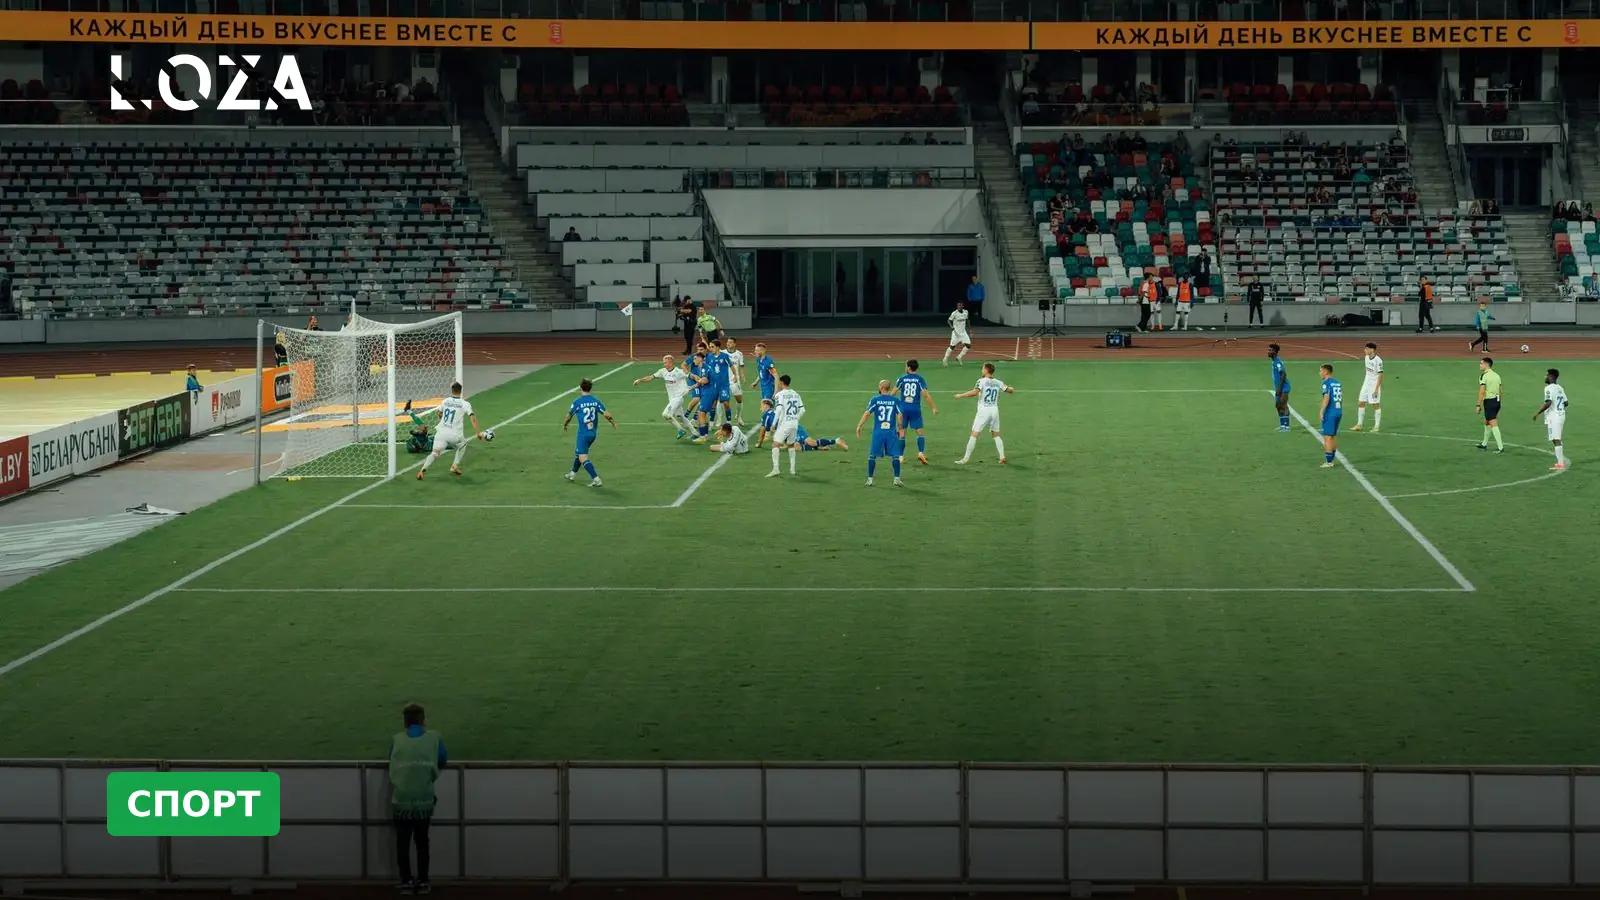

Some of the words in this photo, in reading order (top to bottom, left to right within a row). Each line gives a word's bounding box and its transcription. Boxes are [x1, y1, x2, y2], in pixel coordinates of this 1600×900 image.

[70, 17, 187, 39] КАЖДЫЙ
[198, 21, 265, 41] ДЕНЬ
[274, 22, 387, 41] ВКУСНЕЕ
[396, 24, 493, 42] ВМЕСТЕ
[502, 25, 517, 42] С
[1096, 24, 1208, 47] КАЖДЫЙ
[1218, 27, 1283, 47] ДЕНЬ
[1292, 26, 1402, 44] ВКУСНЕЕ
[1412, 26, 1508, 43] ВМЕСТЕ
[1517, 25, 1532, 42] С
[904, 383, 917, 397] 88
[983, 388, 998, 404] 20
[1332, 386, 1343, 402] 55
[443, 407, 457, 424] 81
[582, 407, 597, 423] 23
[785, 400, 799, 416] 25
[878, 405, 894, 422] 37
[129, 401, 182, 450] BETERA
[43, 422, 118, 473] БЕЛАРУСБАНК
